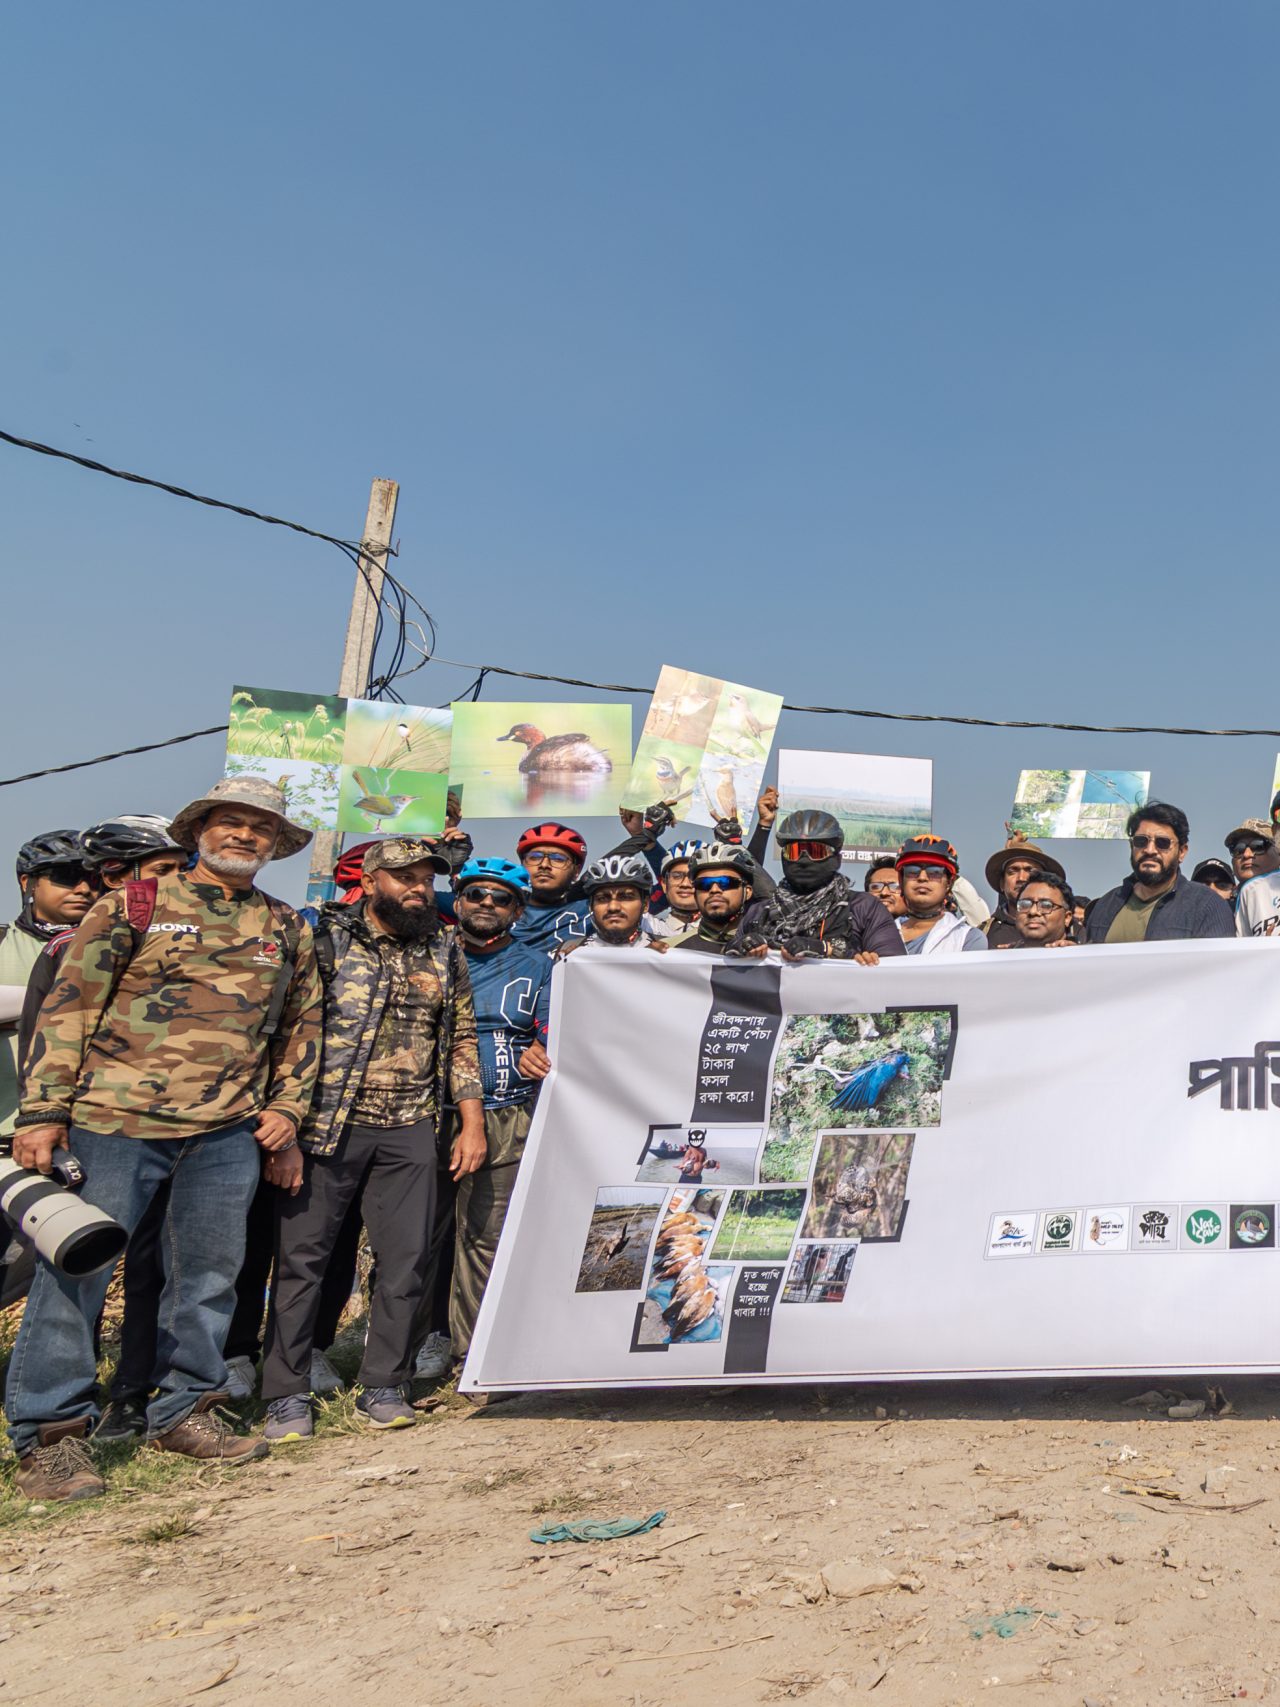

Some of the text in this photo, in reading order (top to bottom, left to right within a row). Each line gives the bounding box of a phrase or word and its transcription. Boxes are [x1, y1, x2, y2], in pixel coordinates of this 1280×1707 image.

[148, 922, 201, 934] SONY
[707, 1026, 741, 1039] একটি
[704, 1042, 750, 1055] ২৫ লাখ
[701, 1056, 735, 1071] টাকার
[700, 1075, 730, 1088] ফসল
[699, 1091, 723, 1105] রক্ষা
